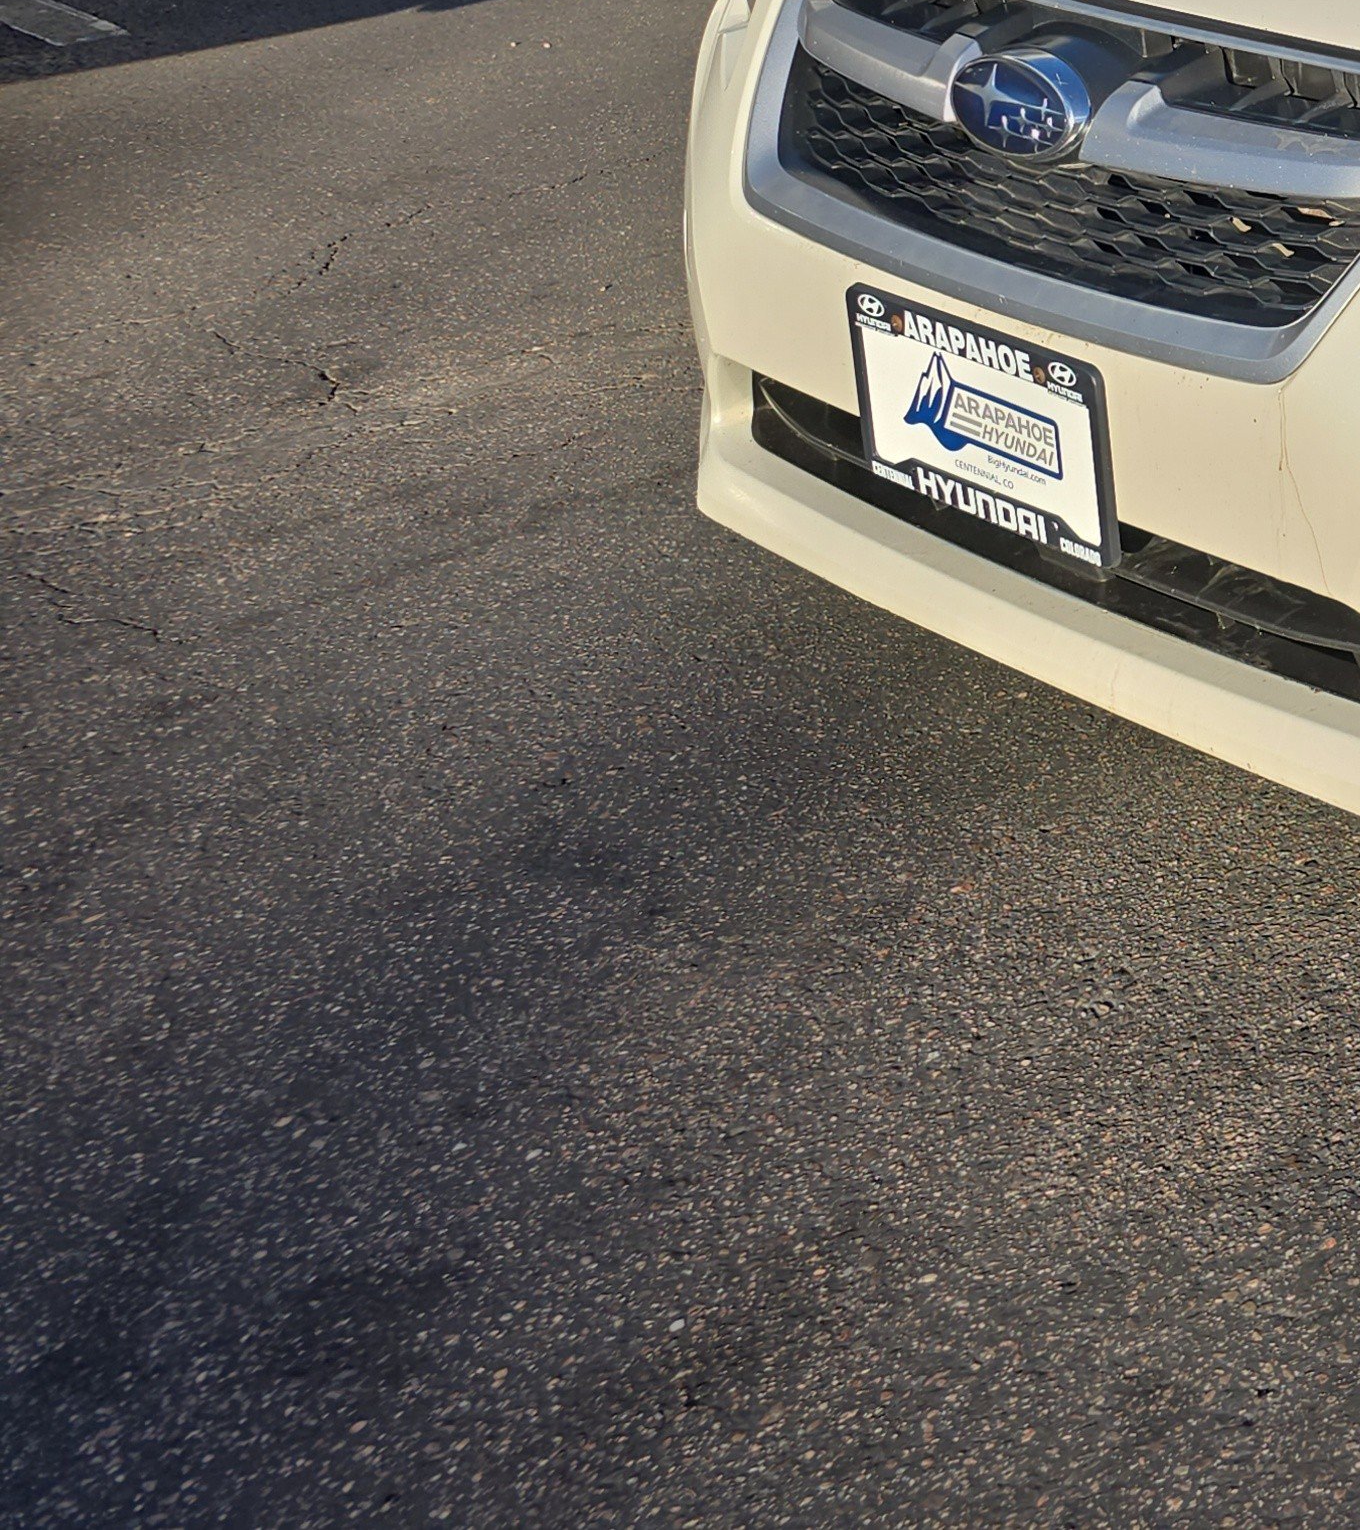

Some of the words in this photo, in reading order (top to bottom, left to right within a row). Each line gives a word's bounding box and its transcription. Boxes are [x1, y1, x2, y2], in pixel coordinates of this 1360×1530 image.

[903, 309, 1035, 382] ARAPAHOE
[953, 390, 1055, 448] ARAPAHOE
[980, 423, 1055, 467] HYUNDAI
[915, 466, 1048, 545] HYUNDAI
[1002, 478, 1014, 490] CO
